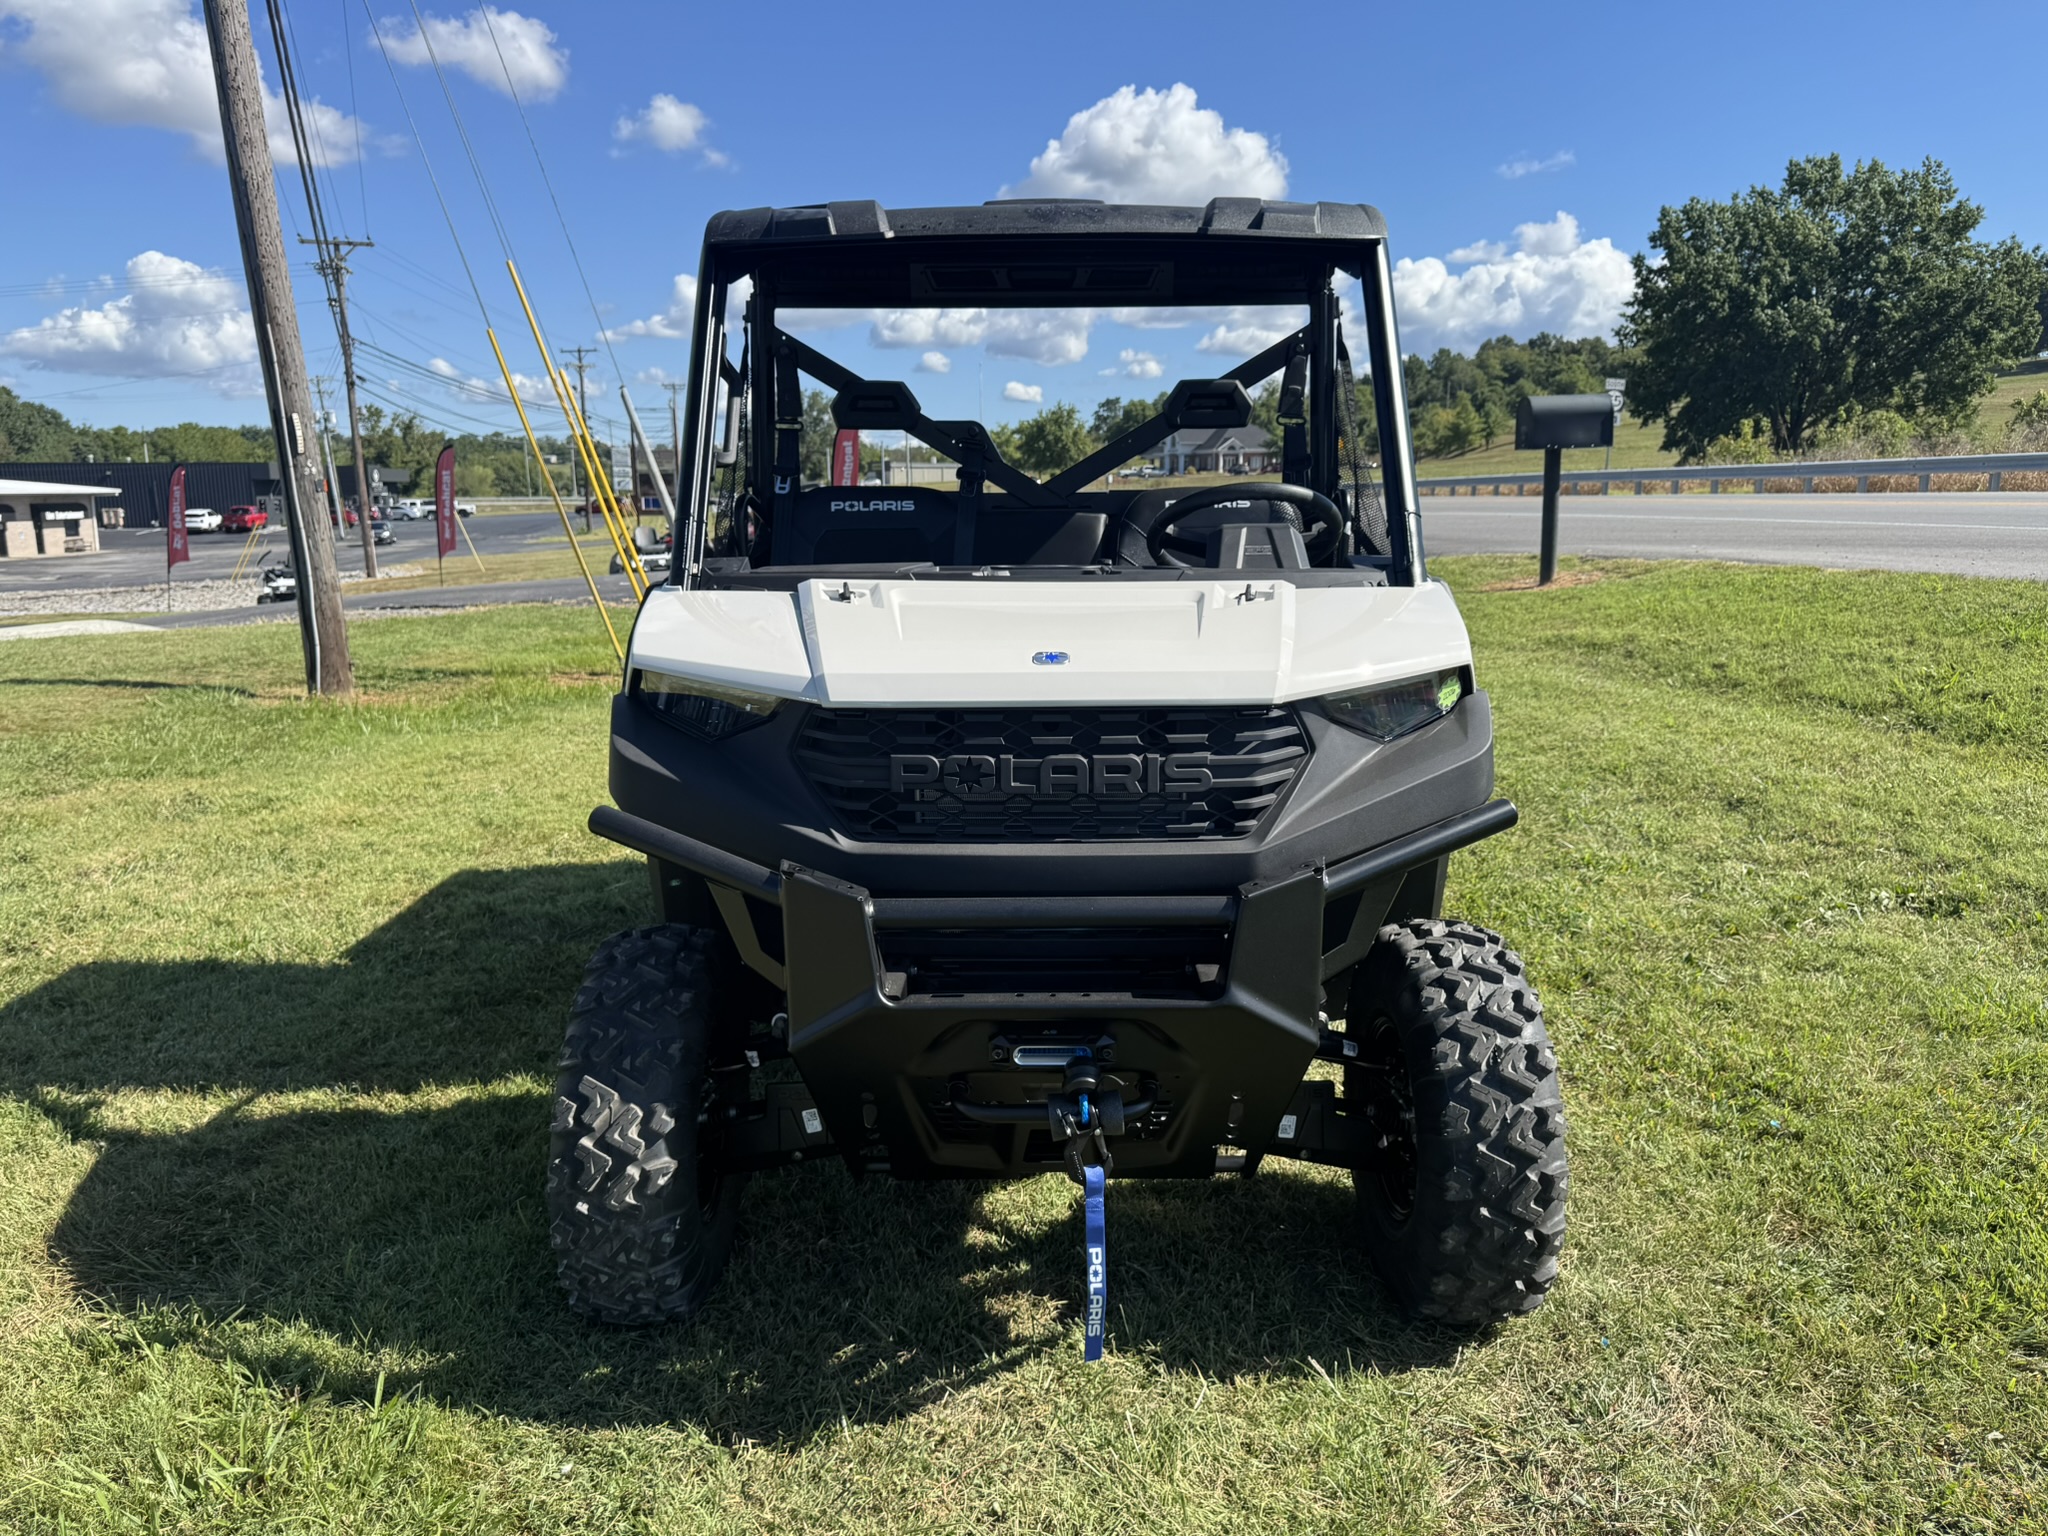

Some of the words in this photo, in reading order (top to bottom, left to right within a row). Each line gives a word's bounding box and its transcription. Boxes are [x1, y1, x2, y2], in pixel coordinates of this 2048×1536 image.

[830, 500, 915, 512] POLARIS
[890, 752, 1213, 793] POLARIS
[1088, 1247, 1103, 1337] POLARIS
